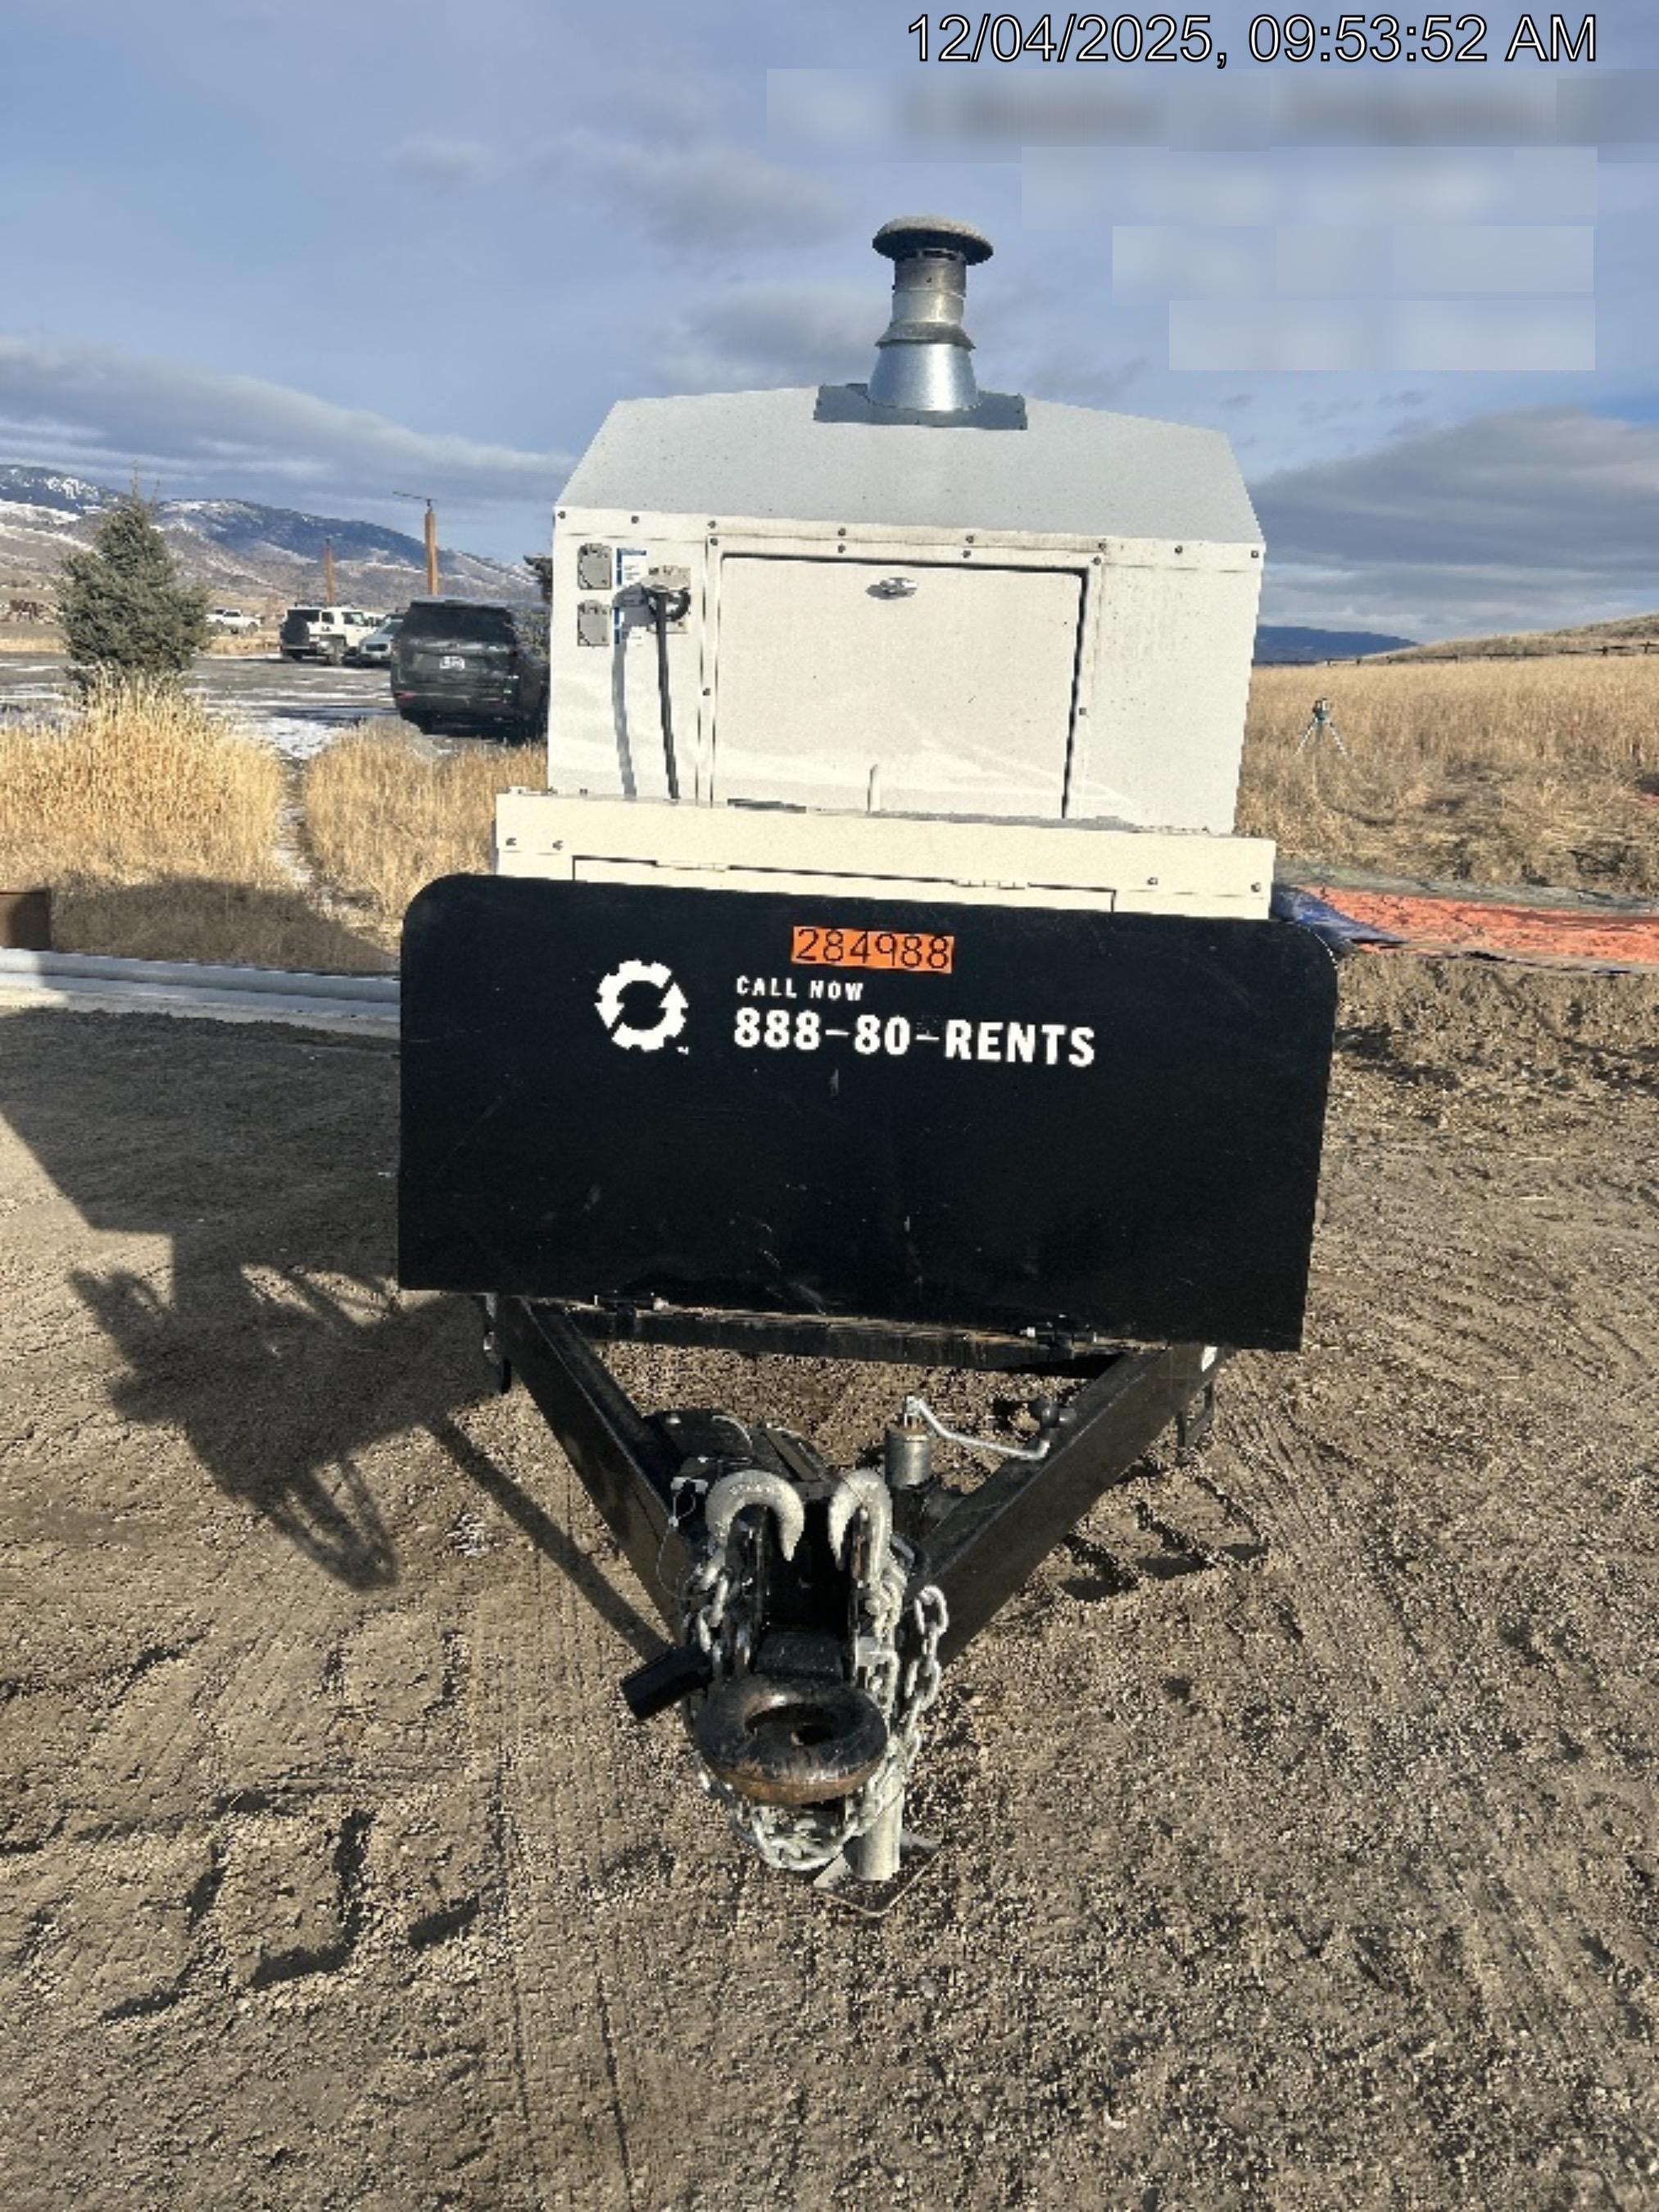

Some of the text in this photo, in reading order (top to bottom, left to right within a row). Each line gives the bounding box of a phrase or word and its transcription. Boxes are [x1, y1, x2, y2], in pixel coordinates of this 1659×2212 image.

[794, 927, 951, 970] 284988
[736, 975, 864, 1001] CALL NOW
[733, 1007, 1095, 1067] 888-80-RENTS
